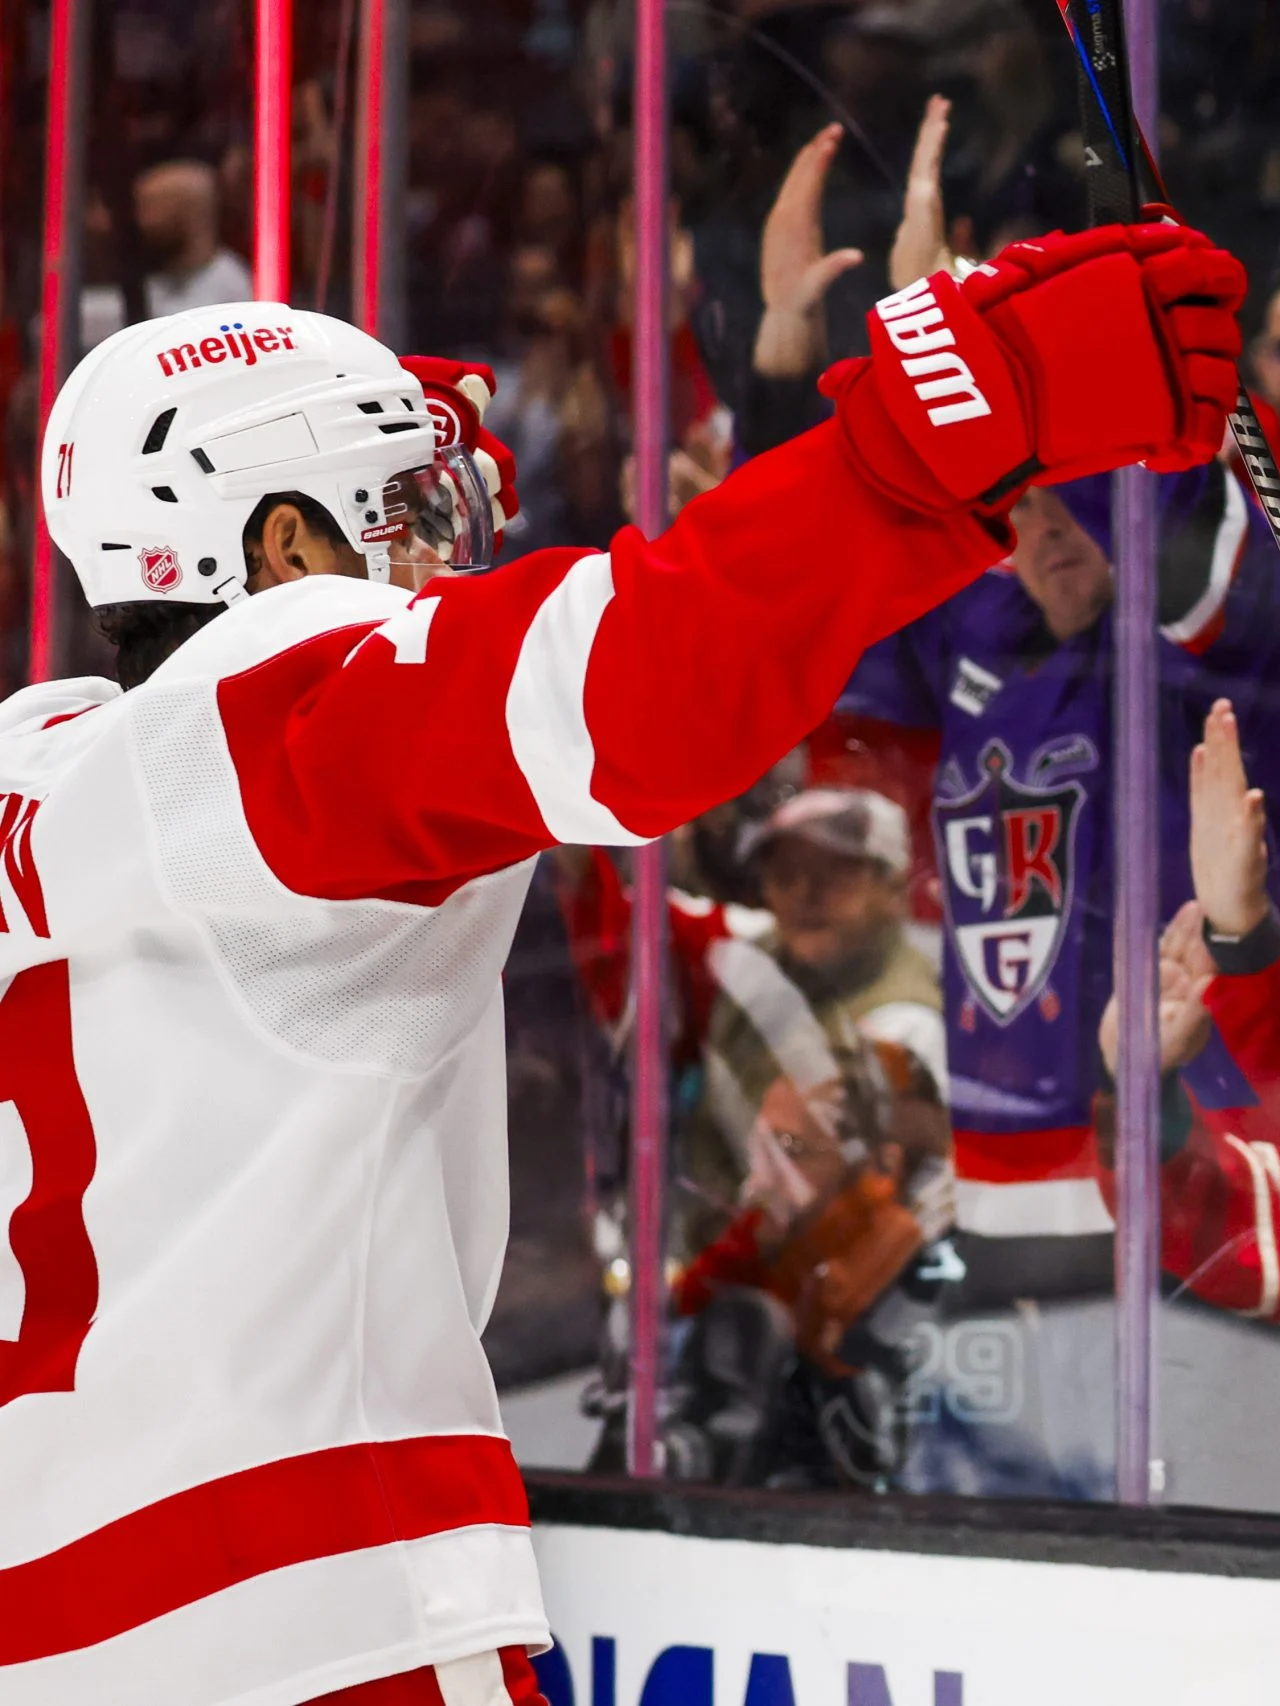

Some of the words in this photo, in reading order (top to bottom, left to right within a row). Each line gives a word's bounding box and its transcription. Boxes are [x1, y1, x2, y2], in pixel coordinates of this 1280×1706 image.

[157, 323, 298, 377] meijer
[56, 443, 75, 498] 71
[363, 523, 403, 540] BAUER
[151, 557, 172, 583] NHL
